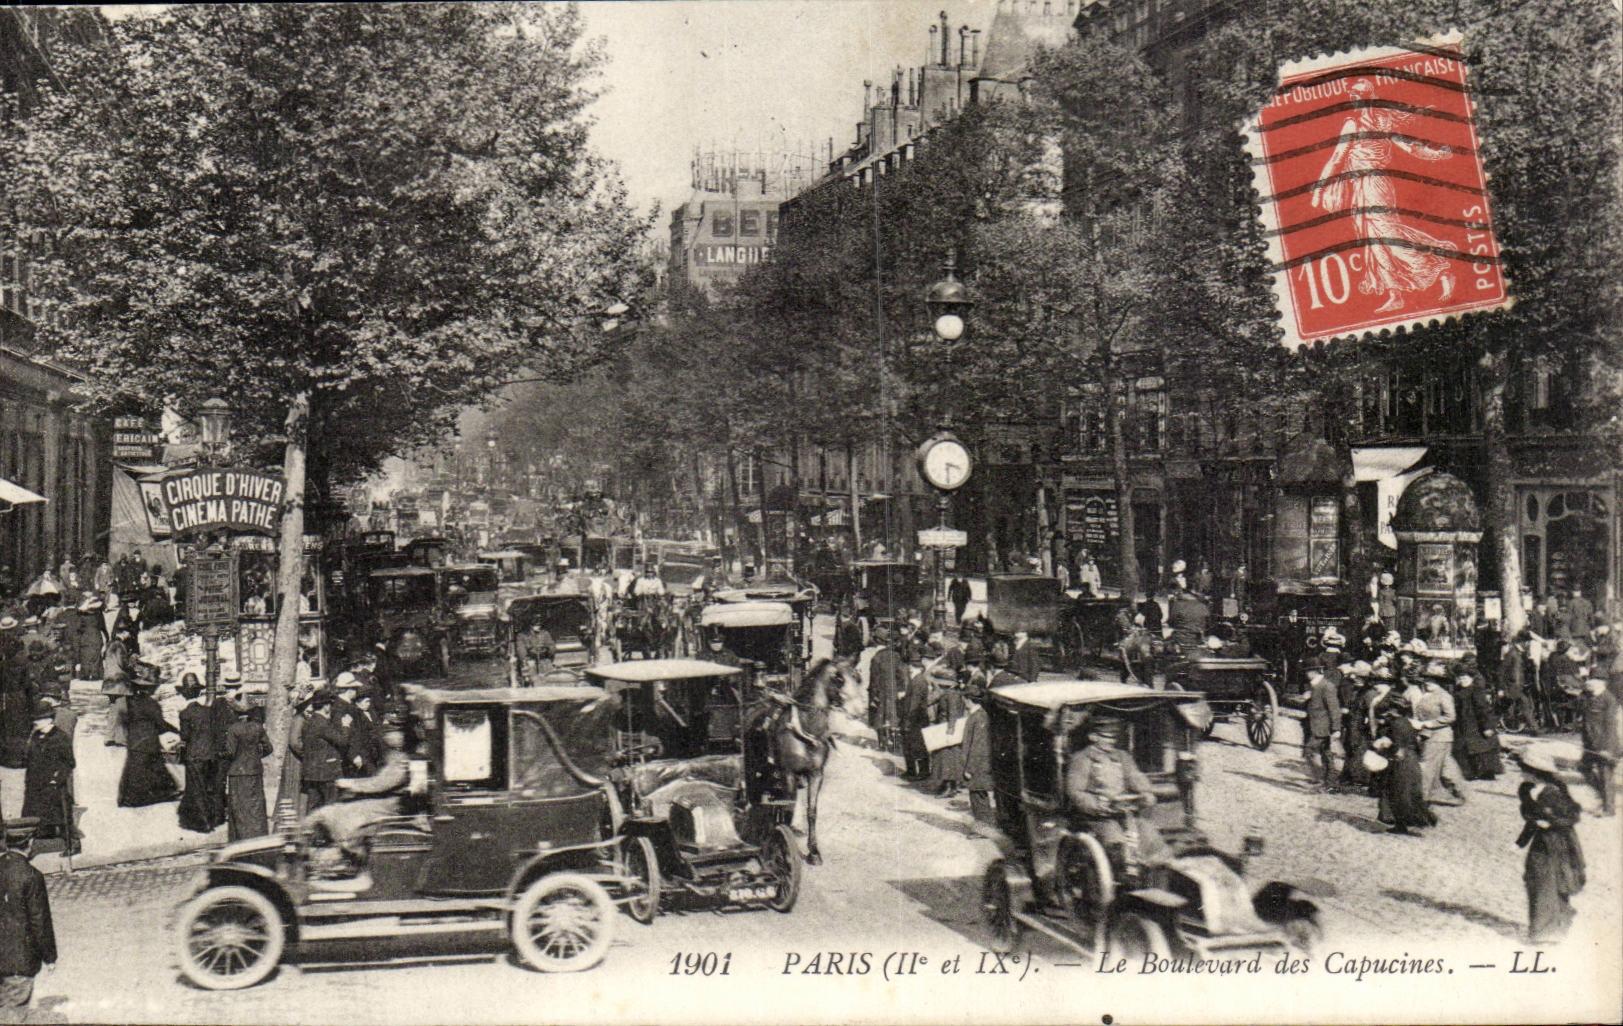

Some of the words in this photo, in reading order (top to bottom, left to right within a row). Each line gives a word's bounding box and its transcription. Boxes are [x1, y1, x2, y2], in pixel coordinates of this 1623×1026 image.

[166, 473, 222, 506] CIRQUE
[225, 472, 282, 504] D'HIVER
[172, 500, 228, 531] CINEMA
